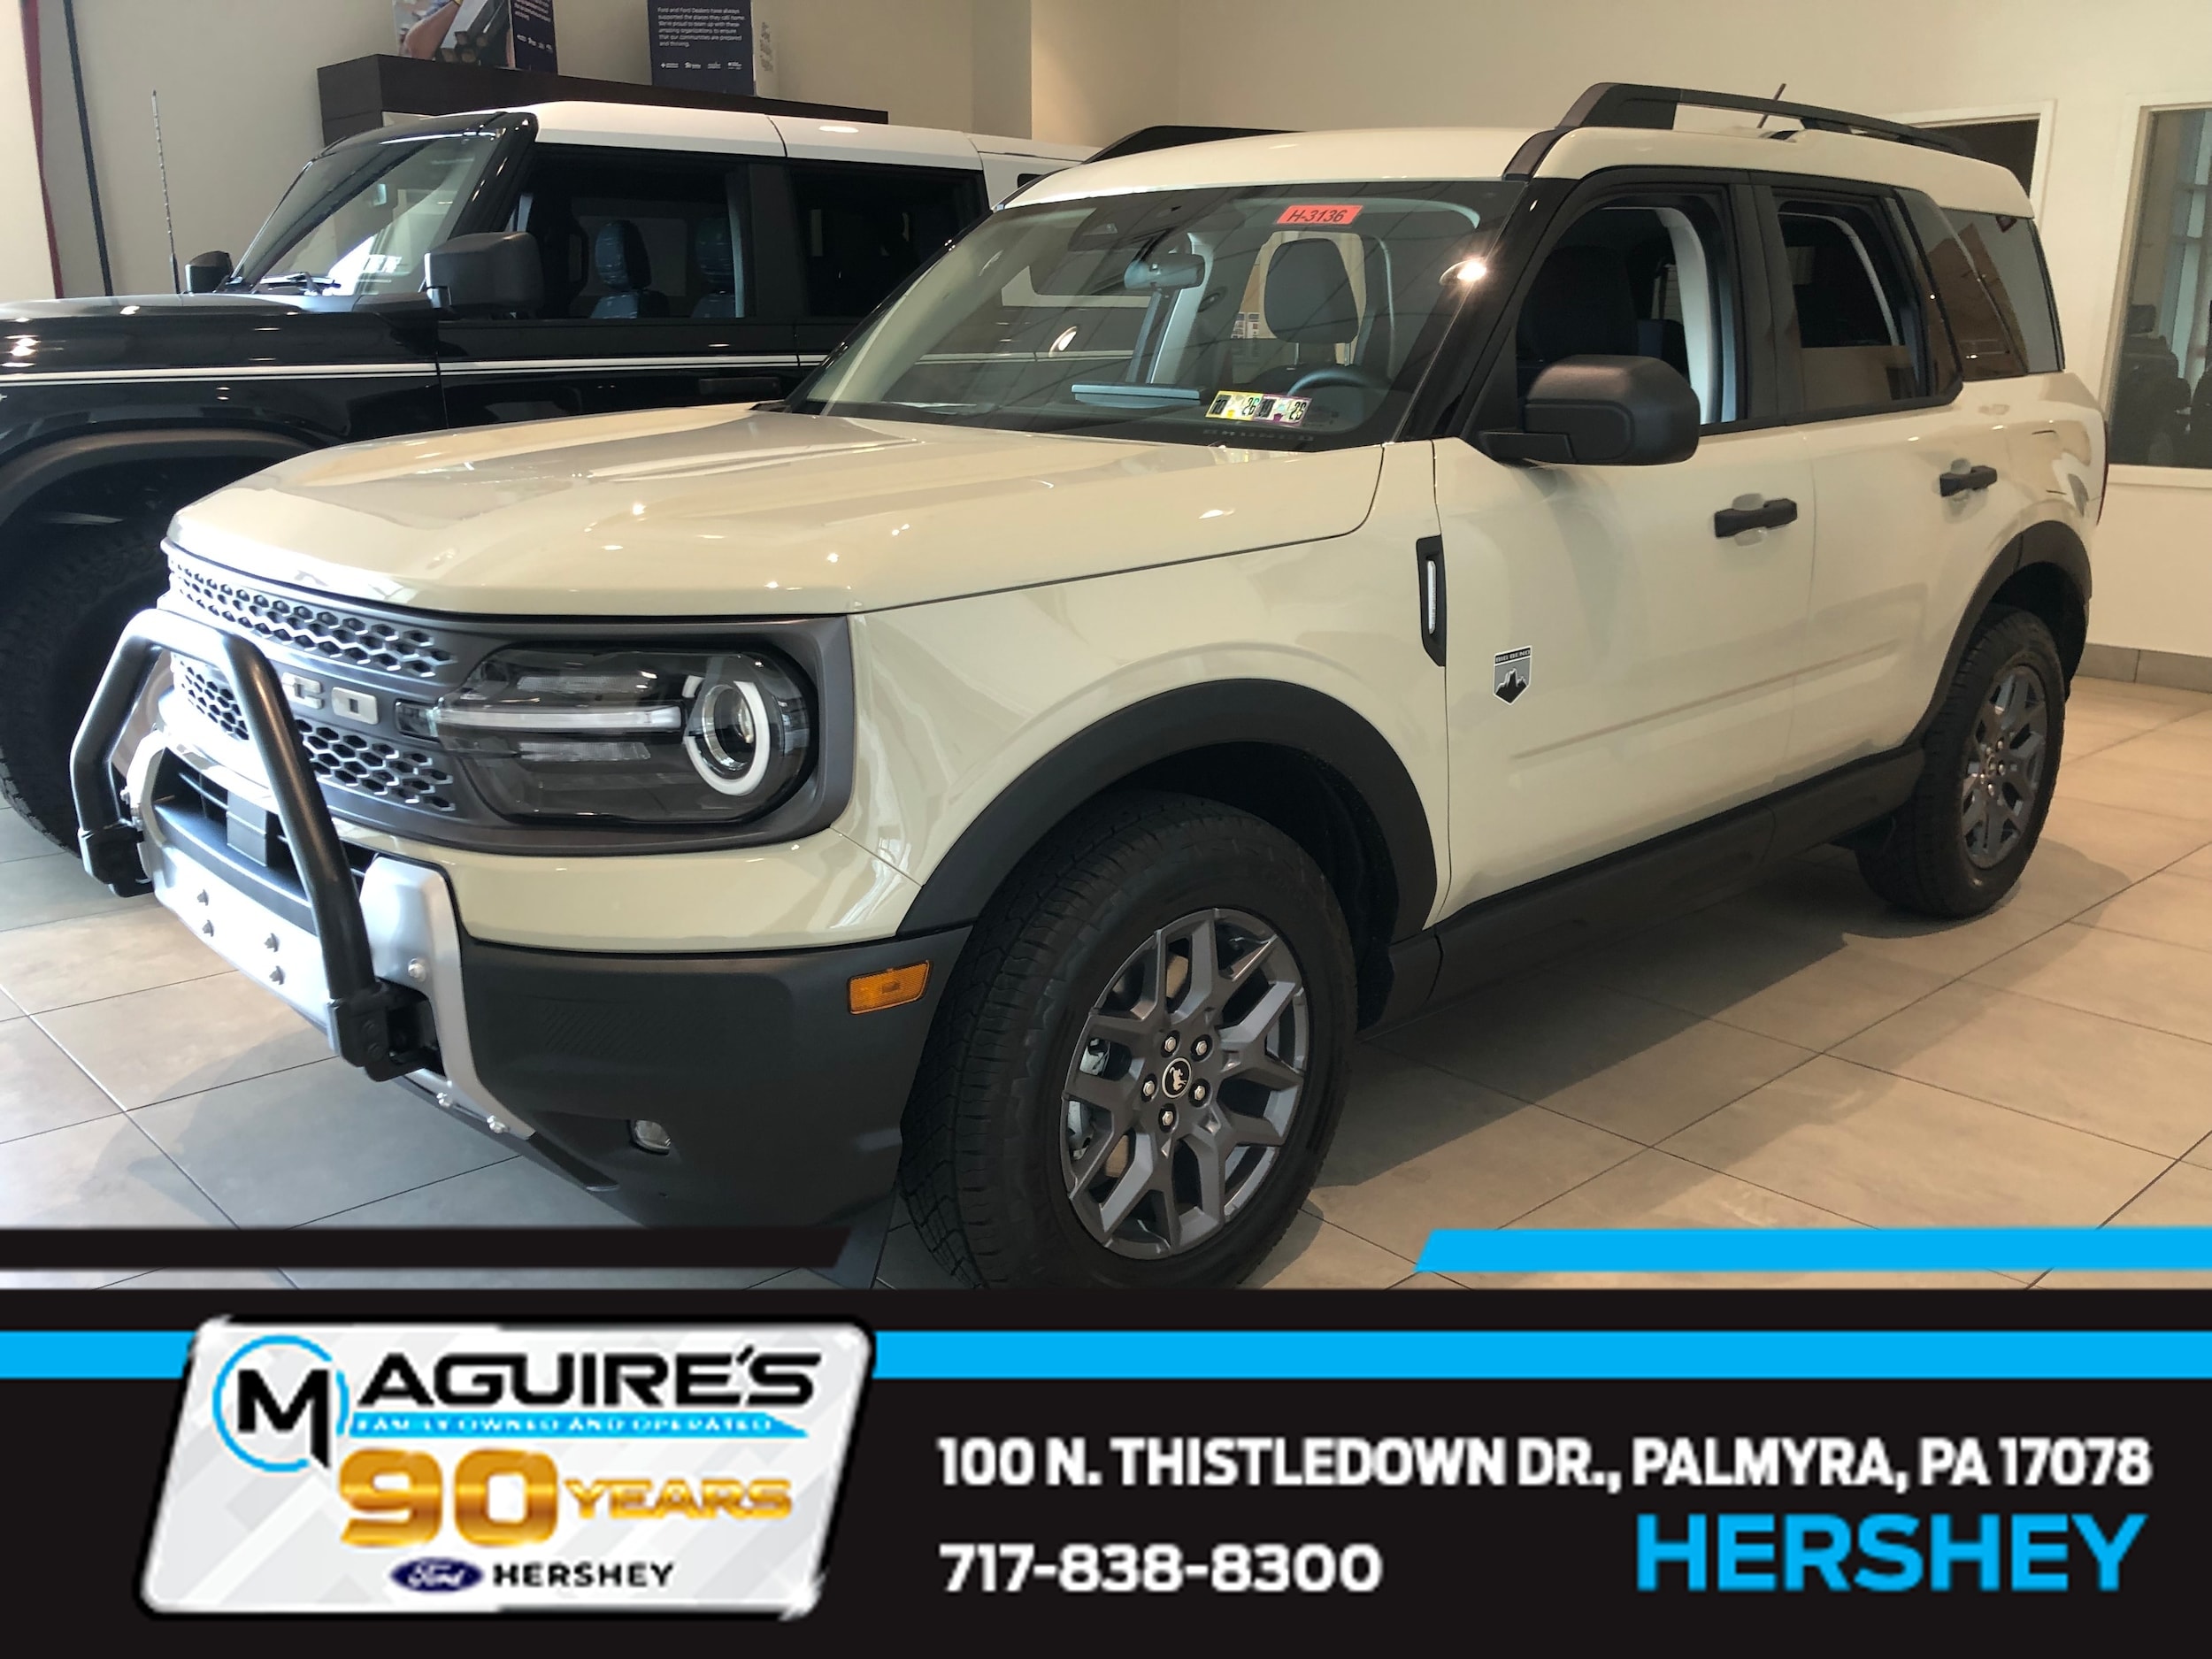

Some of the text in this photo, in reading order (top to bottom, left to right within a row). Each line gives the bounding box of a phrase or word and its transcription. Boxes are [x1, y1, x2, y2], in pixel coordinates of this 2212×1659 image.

[1286, 210, 1348, 222] H-3136
[1242, 397, 1260, 416] 26
[1509, 649, 1531, 659] BEND
